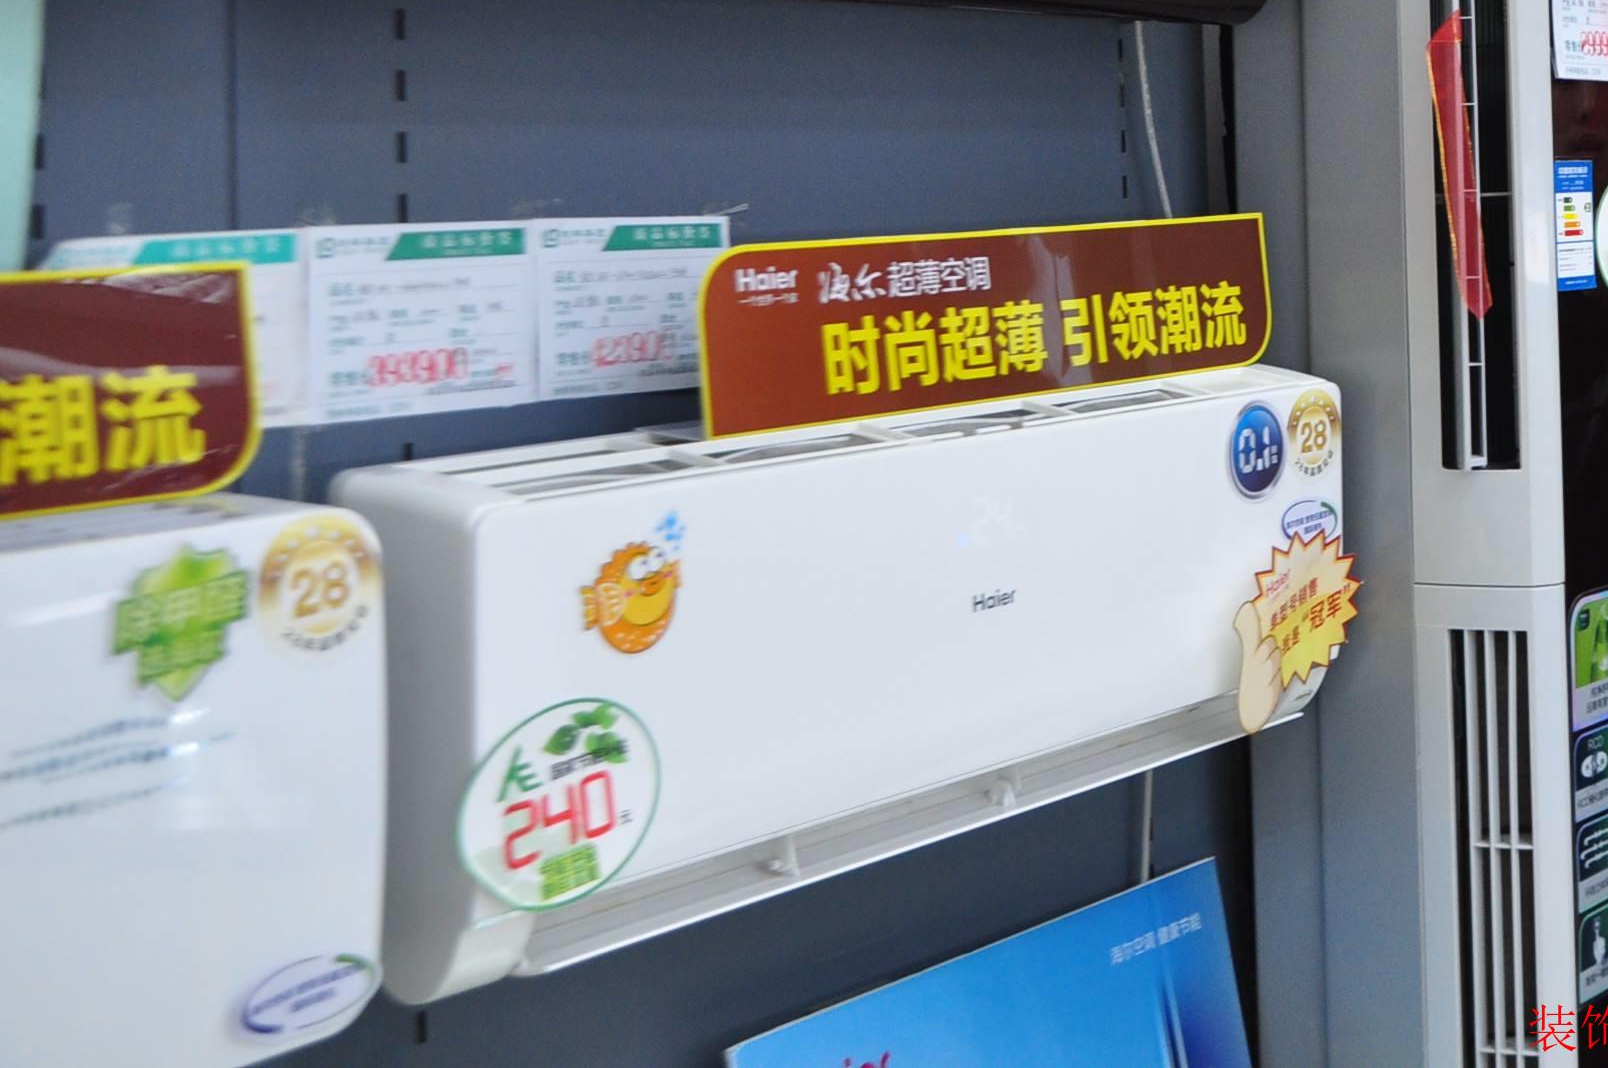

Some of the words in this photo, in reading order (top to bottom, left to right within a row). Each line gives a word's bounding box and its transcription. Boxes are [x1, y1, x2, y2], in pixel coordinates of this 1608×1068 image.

[734, 266, 798, 293] Haier
[817, 255, 991, 304] 海尔超薄空调
[821, 300, 1049, 396] 时尚超薄
[1062, 280, 1247, 366] 引领潮流
[0, 365, 206, 484] 潮流
[1300, 420, 1328, 454] 28
[290, 561, 348, 619] 28
[972, 589, 1016, 613] Haier
[502, 769, 616, 870] 240
